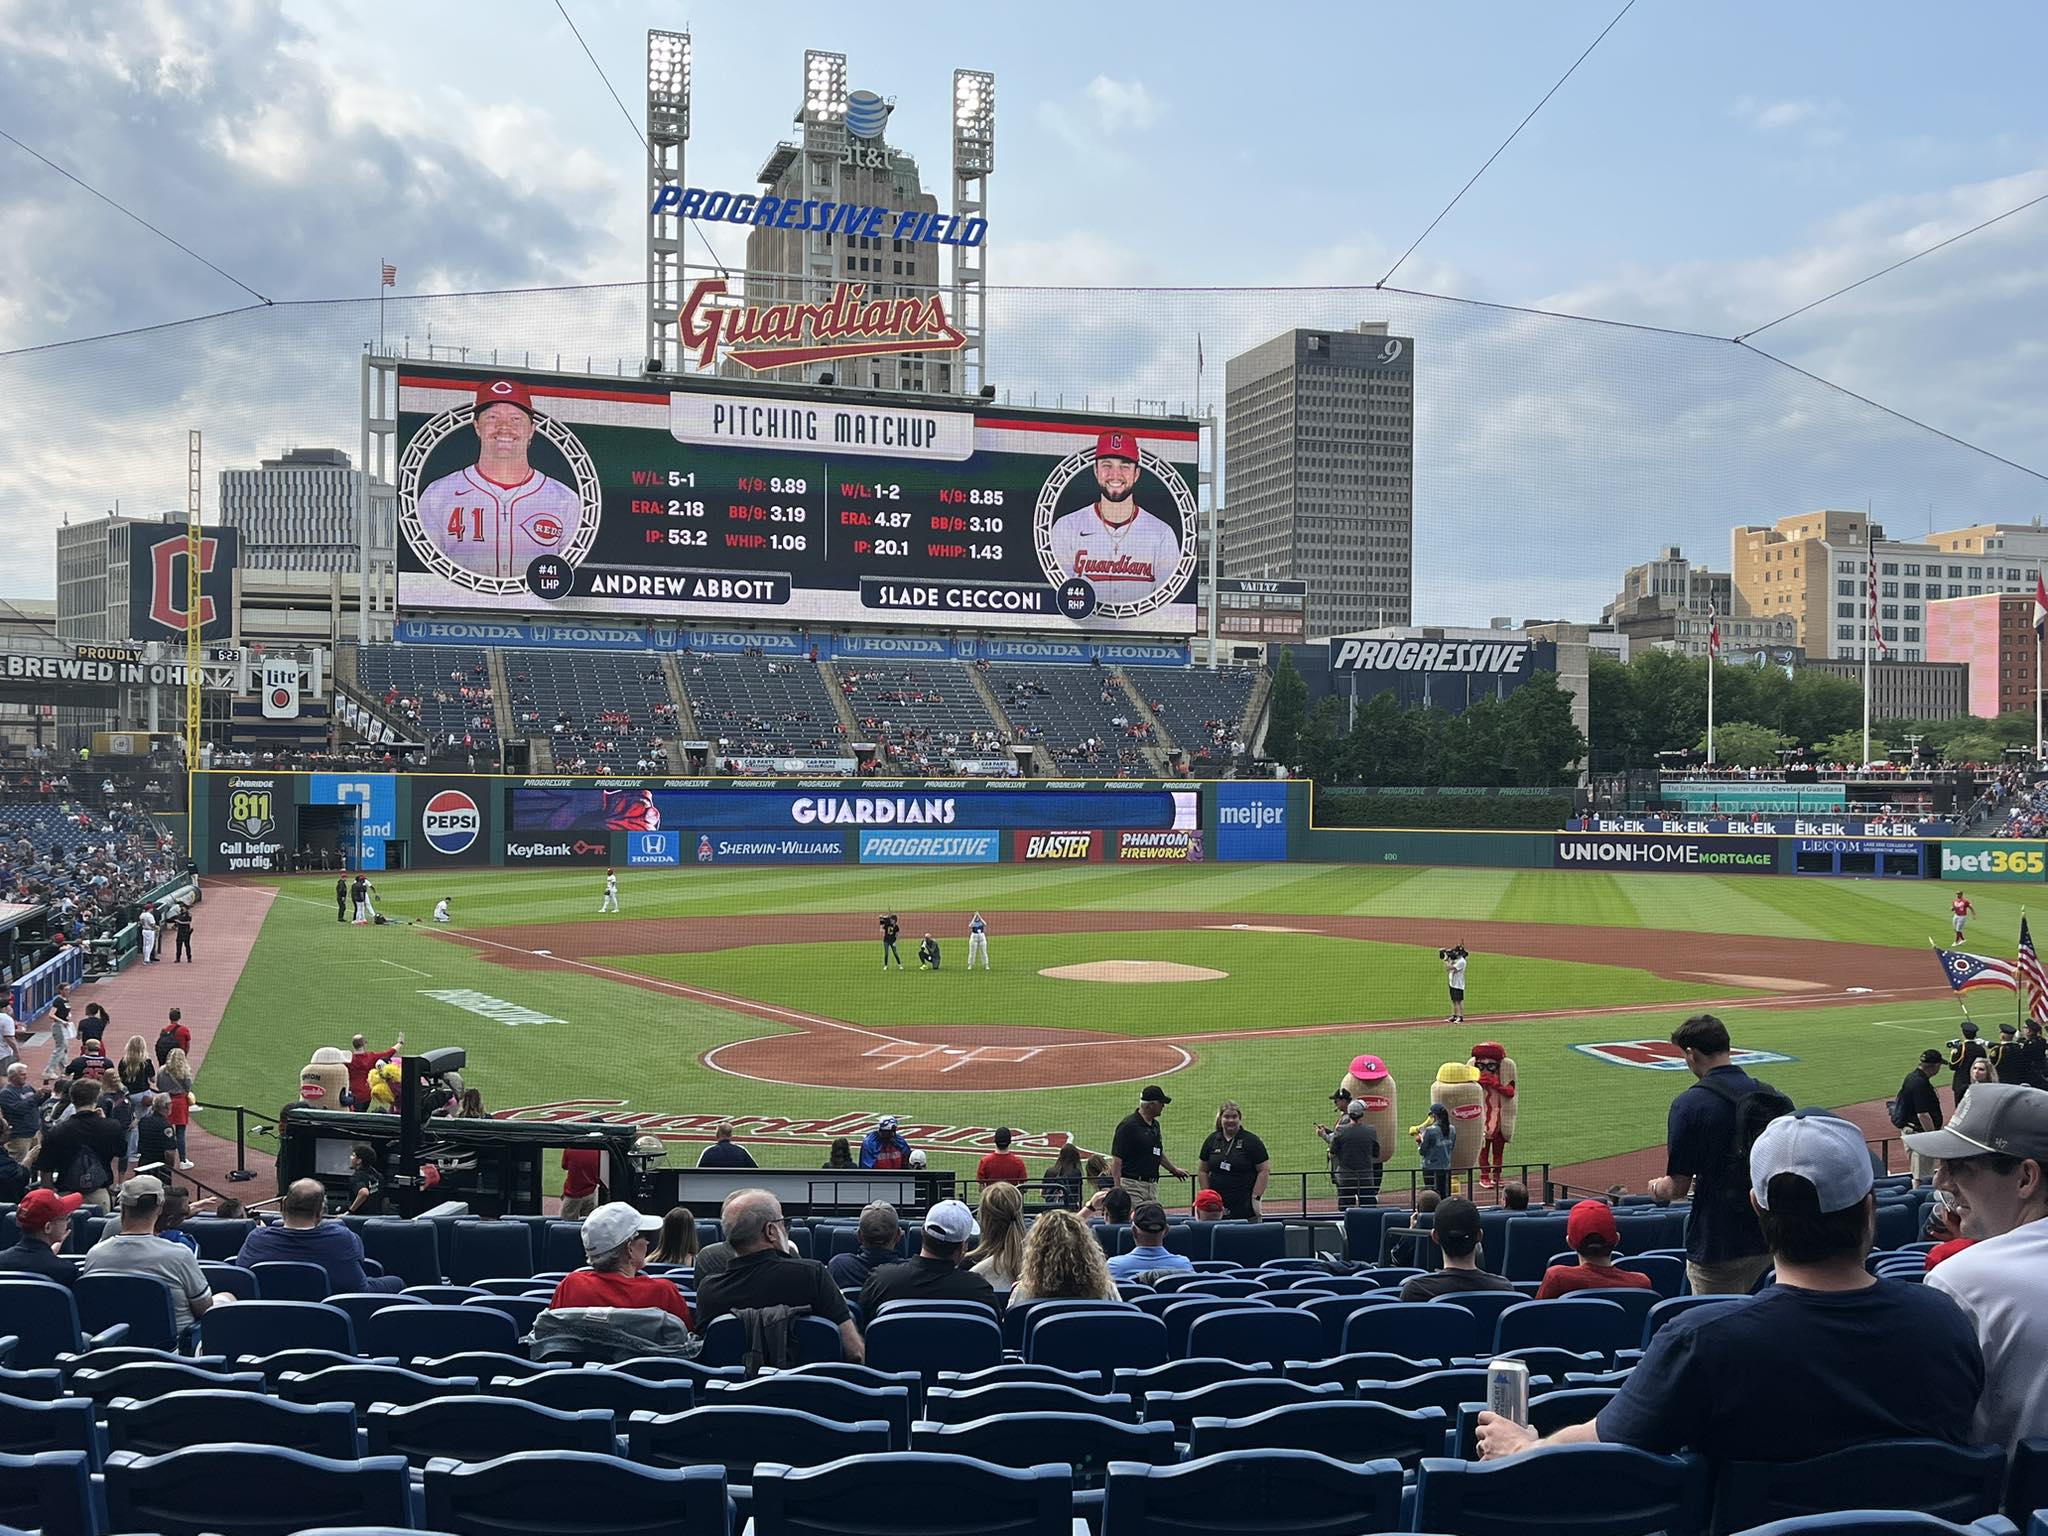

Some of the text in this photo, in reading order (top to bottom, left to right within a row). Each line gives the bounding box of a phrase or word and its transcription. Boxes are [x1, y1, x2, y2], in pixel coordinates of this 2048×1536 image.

[839, 140, 893, 170] at&t
[650, 185, 989, 247] PROGRESSIVE FIELD
[678, 278, 966, 371] Guardians
[1382, 340, 1403, 364] 9
[713, 404, 936, 448] PITCHING MATCHUP
[632, 471, 695, 488] W/L: 5-1
[738, 477, 807, 494] K/9: 9.89
[840, 481, 901, 500] W/L: 1-2
[939, 488, 1004, 506] K/9: 8.85
[631, 500, 705, 517] ERA: 2.18
[729, 505, 806, 523] BB/9: 3.19
[448, 507, 485, 542] 41
[840, 511, 912, 528] ERA: 4.87
[930, 516, 1003, 533] BB/9: 3.10
[535, 523, 563, 538] REDS
[645, 529, 708, 546] IP: 53.2
[725, 533, 807, 551] WHIP: 1.06
[854, 539, 909, 556] IP: 20.1
[927, 543, 1003, 561] WHIP: 1.43
[538, 565, 557, 575] #41
[1073, 550, 1156, 581] Guardians
[541, 580, 560, 590] LHP
[591, 574, 775, 600] ANDREW ABBOTT
[1067, 587, 1085, 597] #44
[879, 586, 1041, 610] SLADE CECCONI
[1068, 600, 1085, 610] RHP
[430, 623, 524, 640] HONDA
[553, 627, 644, 643] HONDA
[710, 632, 797, 649] HONDA
[863, 638, 945, 653] HONDA
[78, 646, 143, 662] PROUDLY
[1005, 643, 1084, 658] HONDA
[1106, 646, 1181, 658] HONDA
[1334, 640, 1529, 673] PROGRESSIVE
[7, 656, 205, 686] BREWED IN OHIO
[266, 669, 296, 687] Lite
[523, 779, 573, 787] PROGRESSIVE
[594, 779, 643, 787] PROGRESSIVE
[663, 780, 711, 788] PROGRESSIVE
[731, 780, 777, 788] PROGRESSIVE
[797, 780, 842, 788] PROGRESSIVE
[862, 781, 906, 789] PROGRESSIVE
[924, 781, 968, 789] PROGRESSIVE
[985, 781, 1029, 789] PROGRESSIVE
[1045, 781, 1088, 789] PROGRESSIVE
[1499, 787, 1551, 796] PROGRESSIVE
[233, 793, 268, 821] 811
[791, 796, 956, 825] GUARDIANS
[1220, 801, 1284, 829] meijer
[426, 815, 477, 829] PEPSI
[220, 842, 242, 855] Call
[863, 837, 994, 857] PROGRESSIVE
[1026, 836, 1091, 858] BLASTER
[1121, 833, 1188, 847] PHANTOM
[507, 843, 571, 859] KeyBank
[631, 855, 675, 863] HONDA
[1120, 847, 1188, 860] FIREWORKS
[1383, 852, 1398, 861] 400
[1699, 853, 1772, 865] MORTGAGE
[229, 854, 273, 871] you dig.
[1943, 849, 2044, 873] bet365
